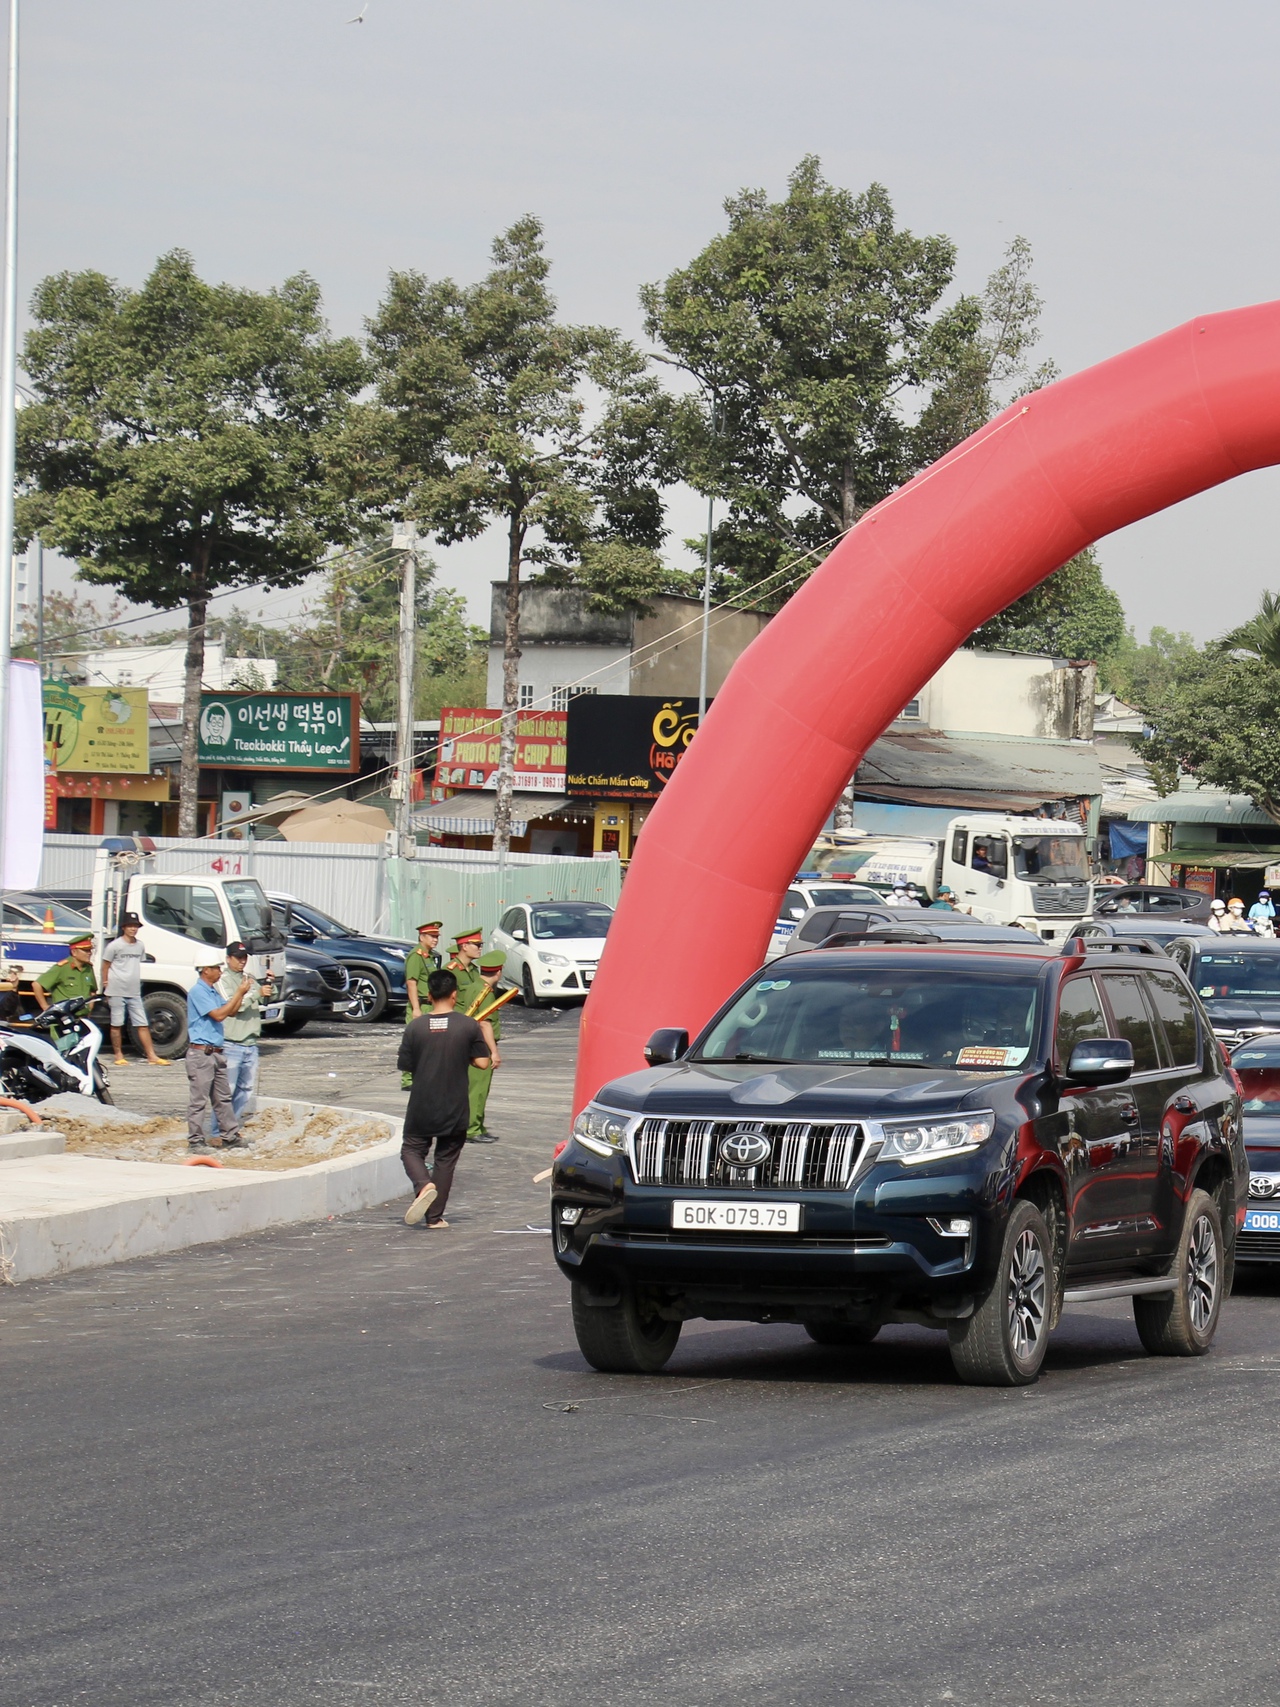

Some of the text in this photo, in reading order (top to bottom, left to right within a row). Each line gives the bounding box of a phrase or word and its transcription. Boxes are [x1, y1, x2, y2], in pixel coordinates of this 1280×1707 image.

[238, 702, 342, 734] 이선생 떡볶이
[234, 738, 332, 757] Tteokbokki Thầy Lee
[456, 742, 487, 764] PHOTO
[524, 744, 550, 770] CHỤP
[568, 773, 649, 789] Nước Chấm Mắm Gừng
[603, 833, 616, 842] 174
[684, 1206, 787, 1226] 60K-079.79
